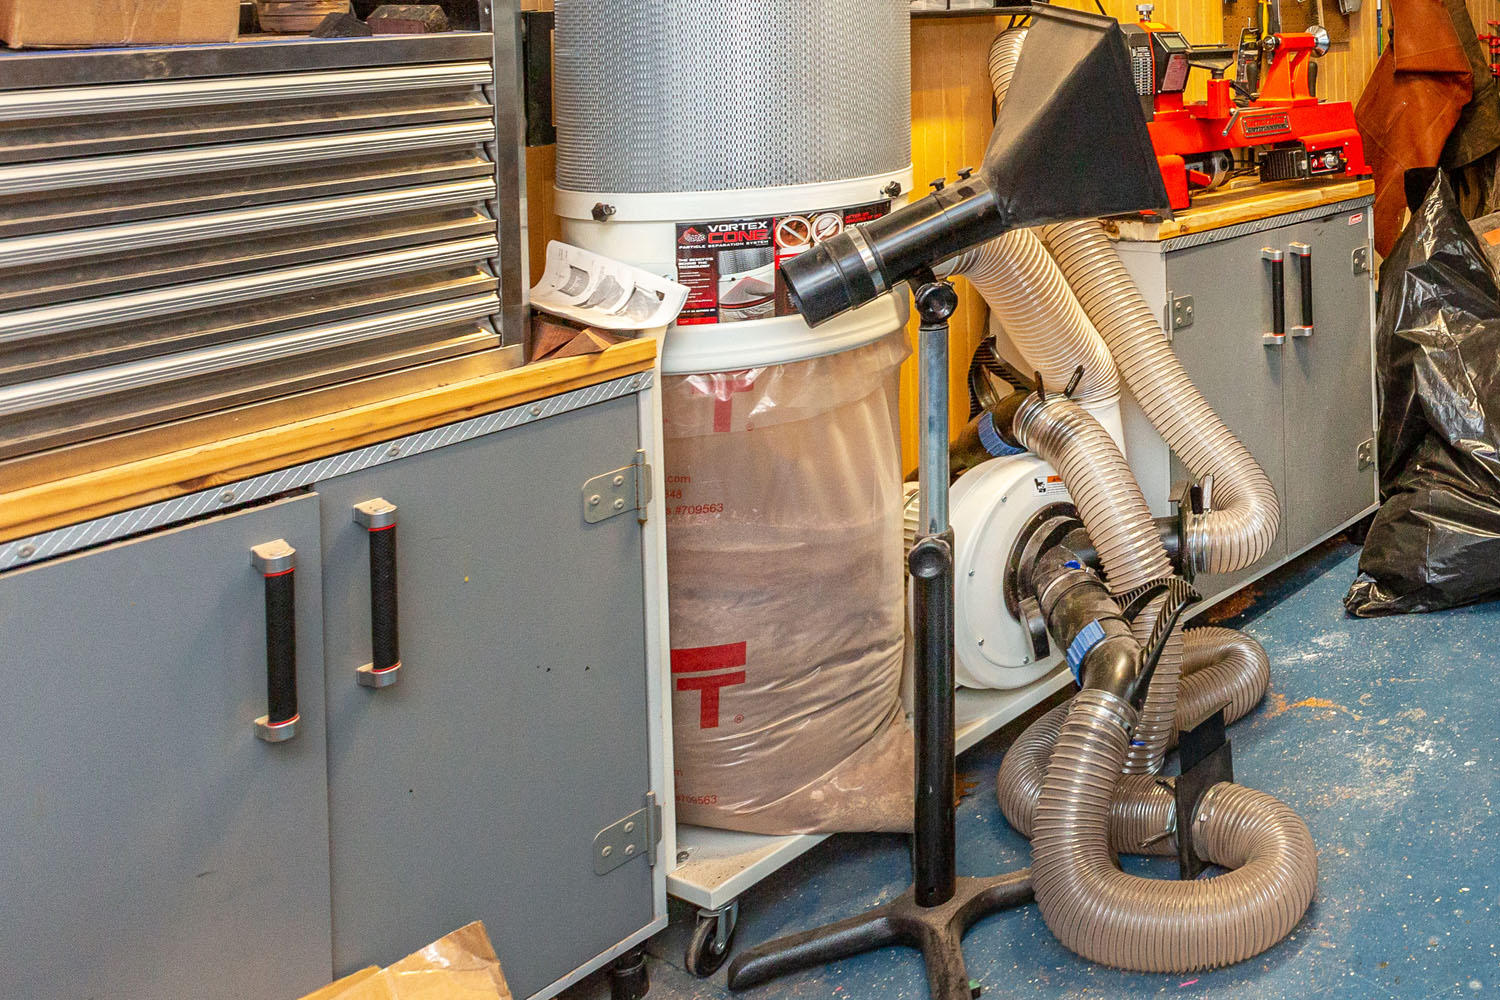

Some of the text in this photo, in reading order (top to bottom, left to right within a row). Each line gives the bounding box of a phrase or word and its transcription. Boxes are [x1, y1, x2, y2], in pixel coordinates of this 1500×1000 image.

[707, 221, 768, 232] VORTEX
[707, 229, 769, 244] CONE
[675, 502, 724, 515] #709563
